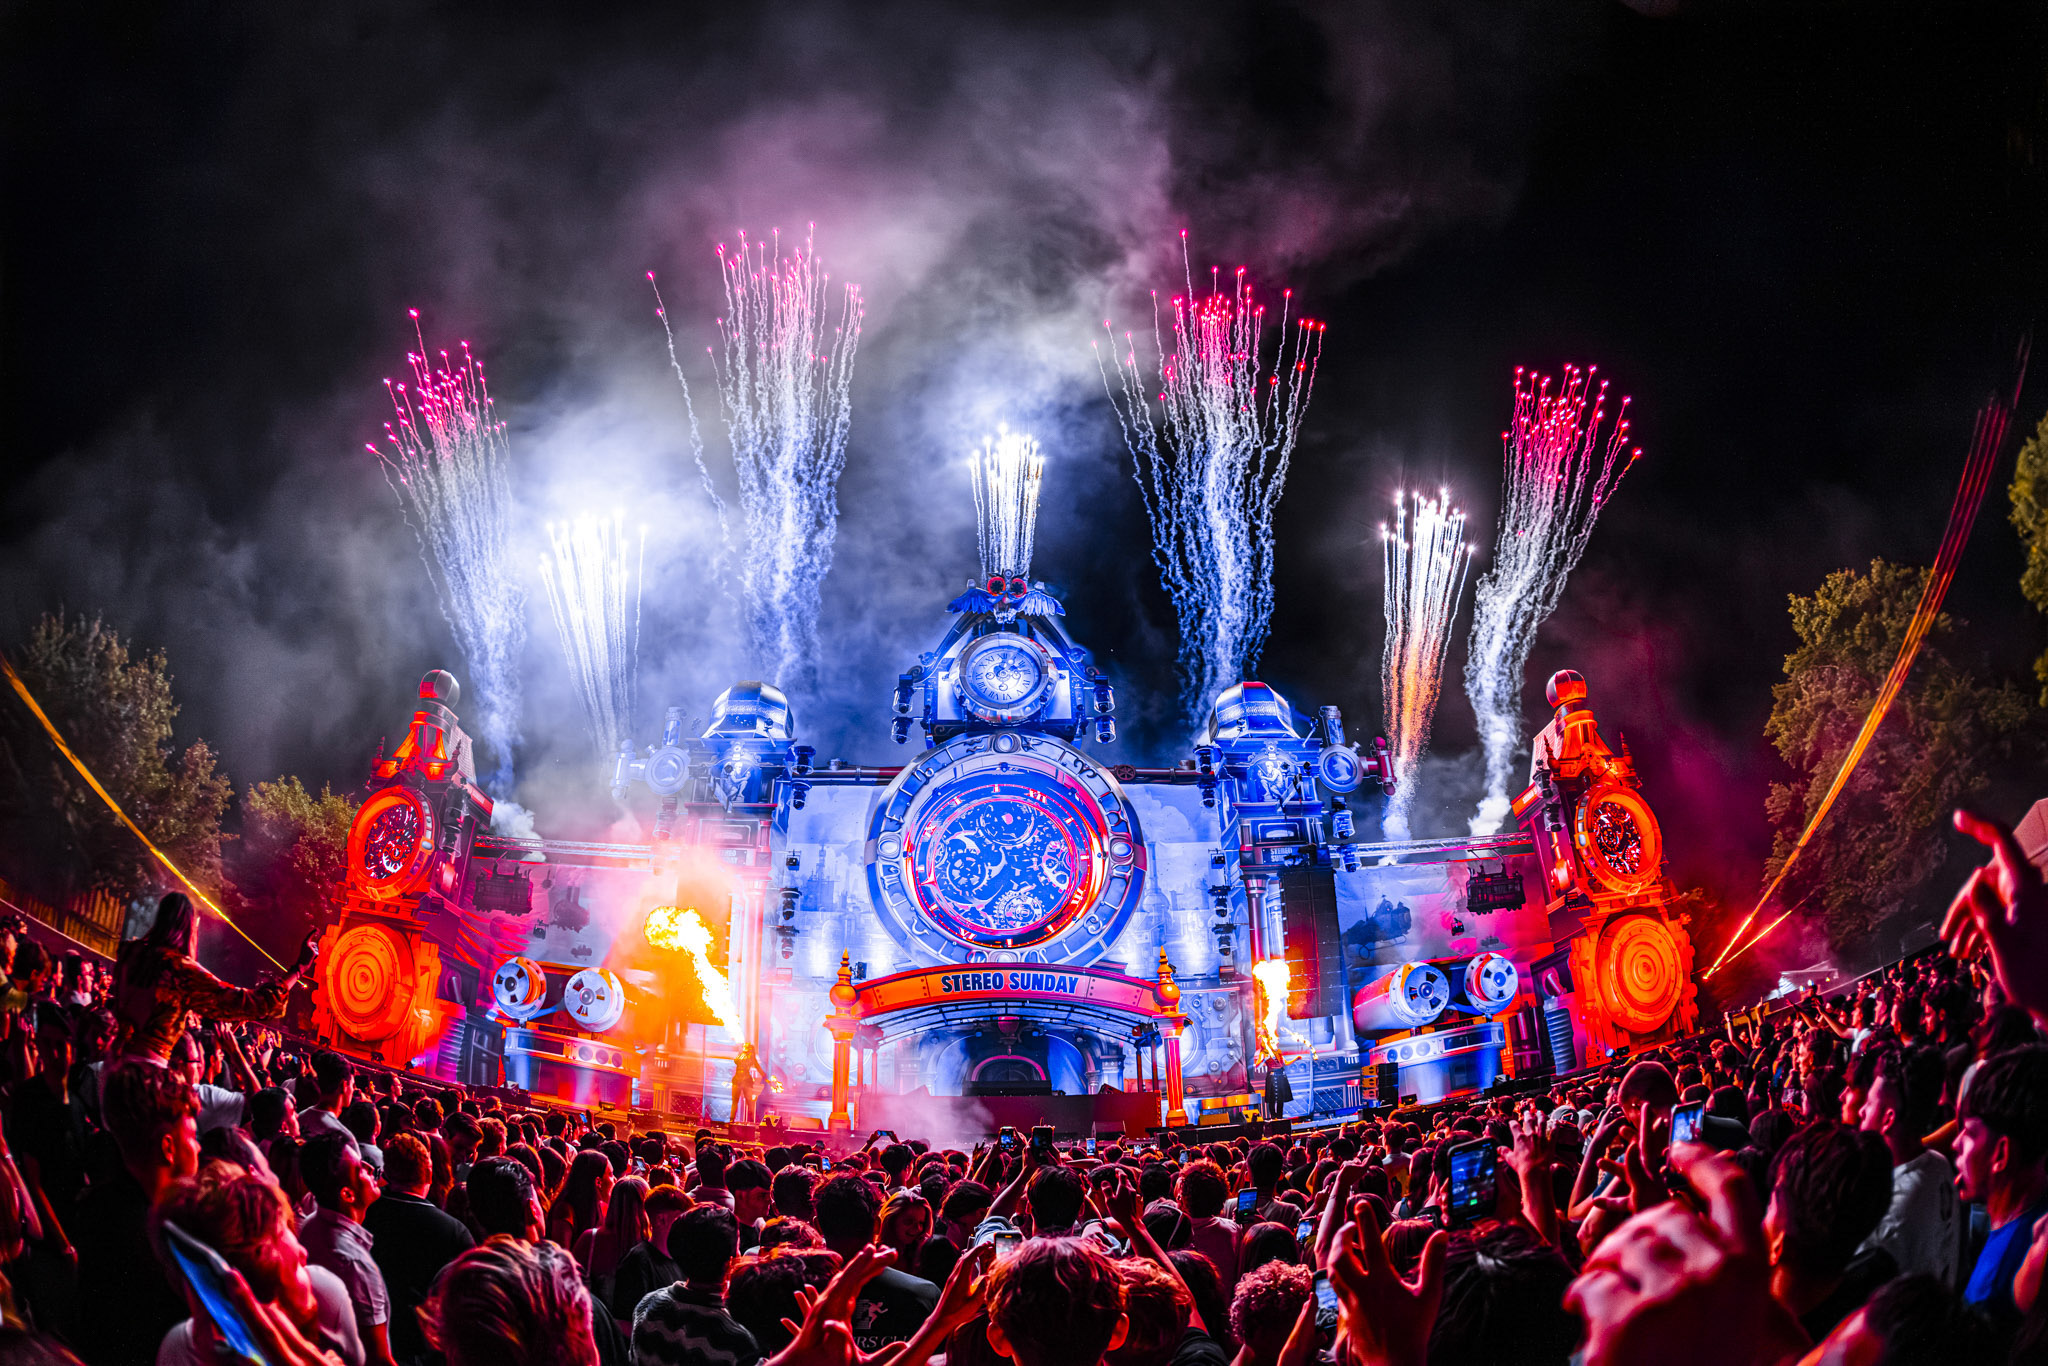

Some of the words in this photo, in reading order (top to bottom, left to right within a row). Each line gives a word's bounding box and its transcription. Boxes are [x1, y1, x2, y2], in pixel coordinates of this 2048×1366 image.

[1270, 847, 1293, 855] STEREO
[941, 972, 1005, 993] STEREO
[1008, 972, 1079, 994] SUNDAY
